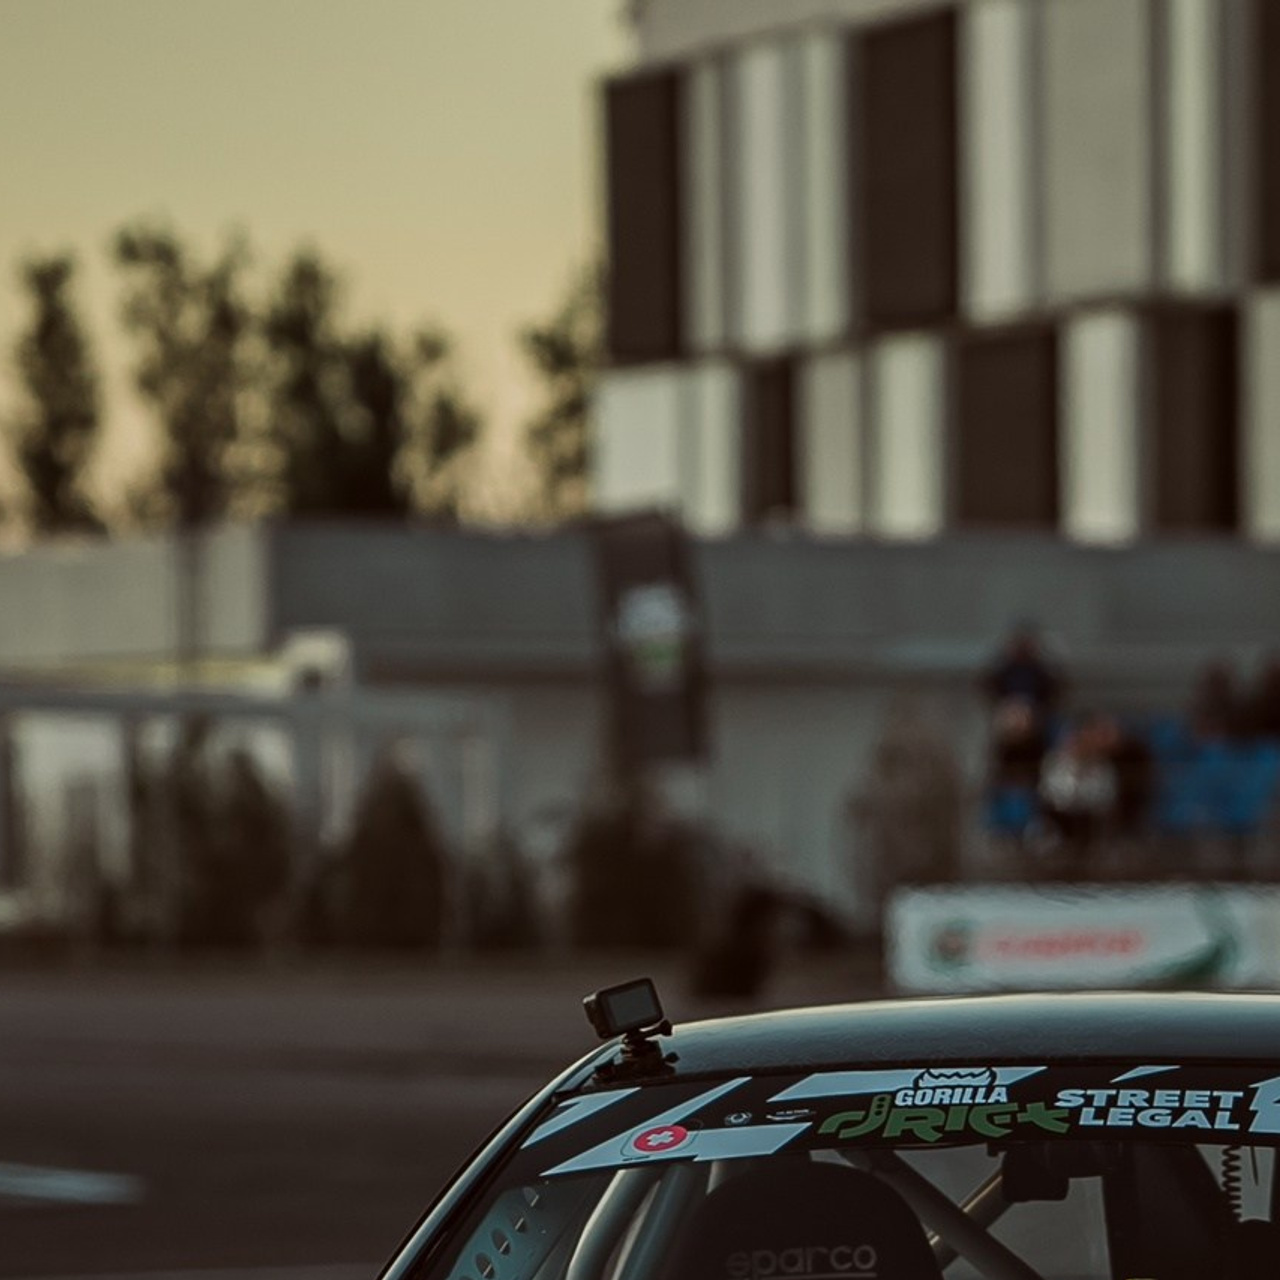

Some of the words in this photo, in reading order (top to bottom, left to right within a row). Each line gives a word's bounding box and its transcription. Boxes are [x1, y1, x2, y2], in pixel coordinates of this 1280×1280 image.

[893, 1085, 1009, 1107] GORILLA
[1054, 1088, 1244, 1109] STREET
[1078, 1107, 1242, 1131] LEGAL
[727, 1241, 877, 1280] sparco
